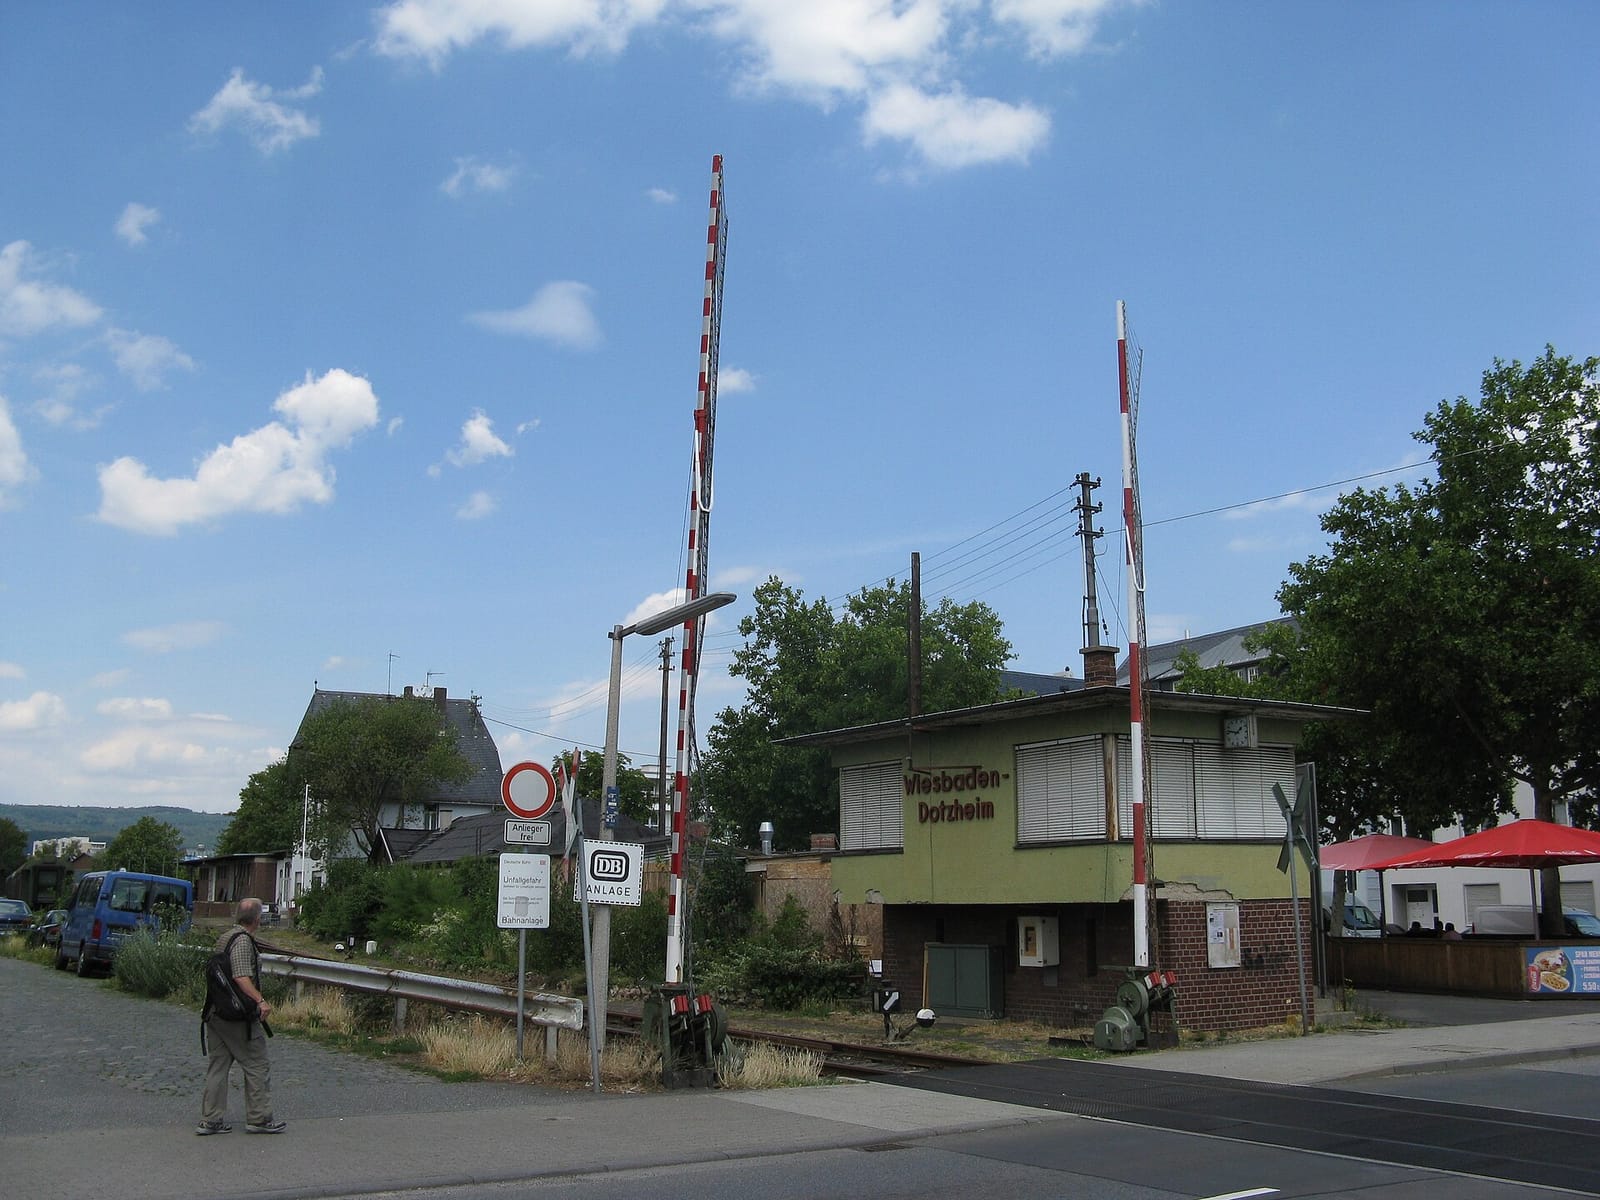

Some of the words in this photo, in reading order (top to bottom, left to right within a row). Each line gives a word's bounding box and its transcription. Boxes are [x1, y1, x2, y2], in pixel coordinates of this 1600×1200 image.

[903, 768, 1009, 795] Wiesbaden-
[918, 797, 994, 823] Dotzheim
[512, 823, 544, 835] Anlieger
[520, 832, 534, 841] frei
[597, 858, 622, 874] DB
[503, 876, 542, 885] Unfallgefahr
[586, 884, 631, 897] ANLAGE
[501, 915, 544, 926] Bahnanlage
